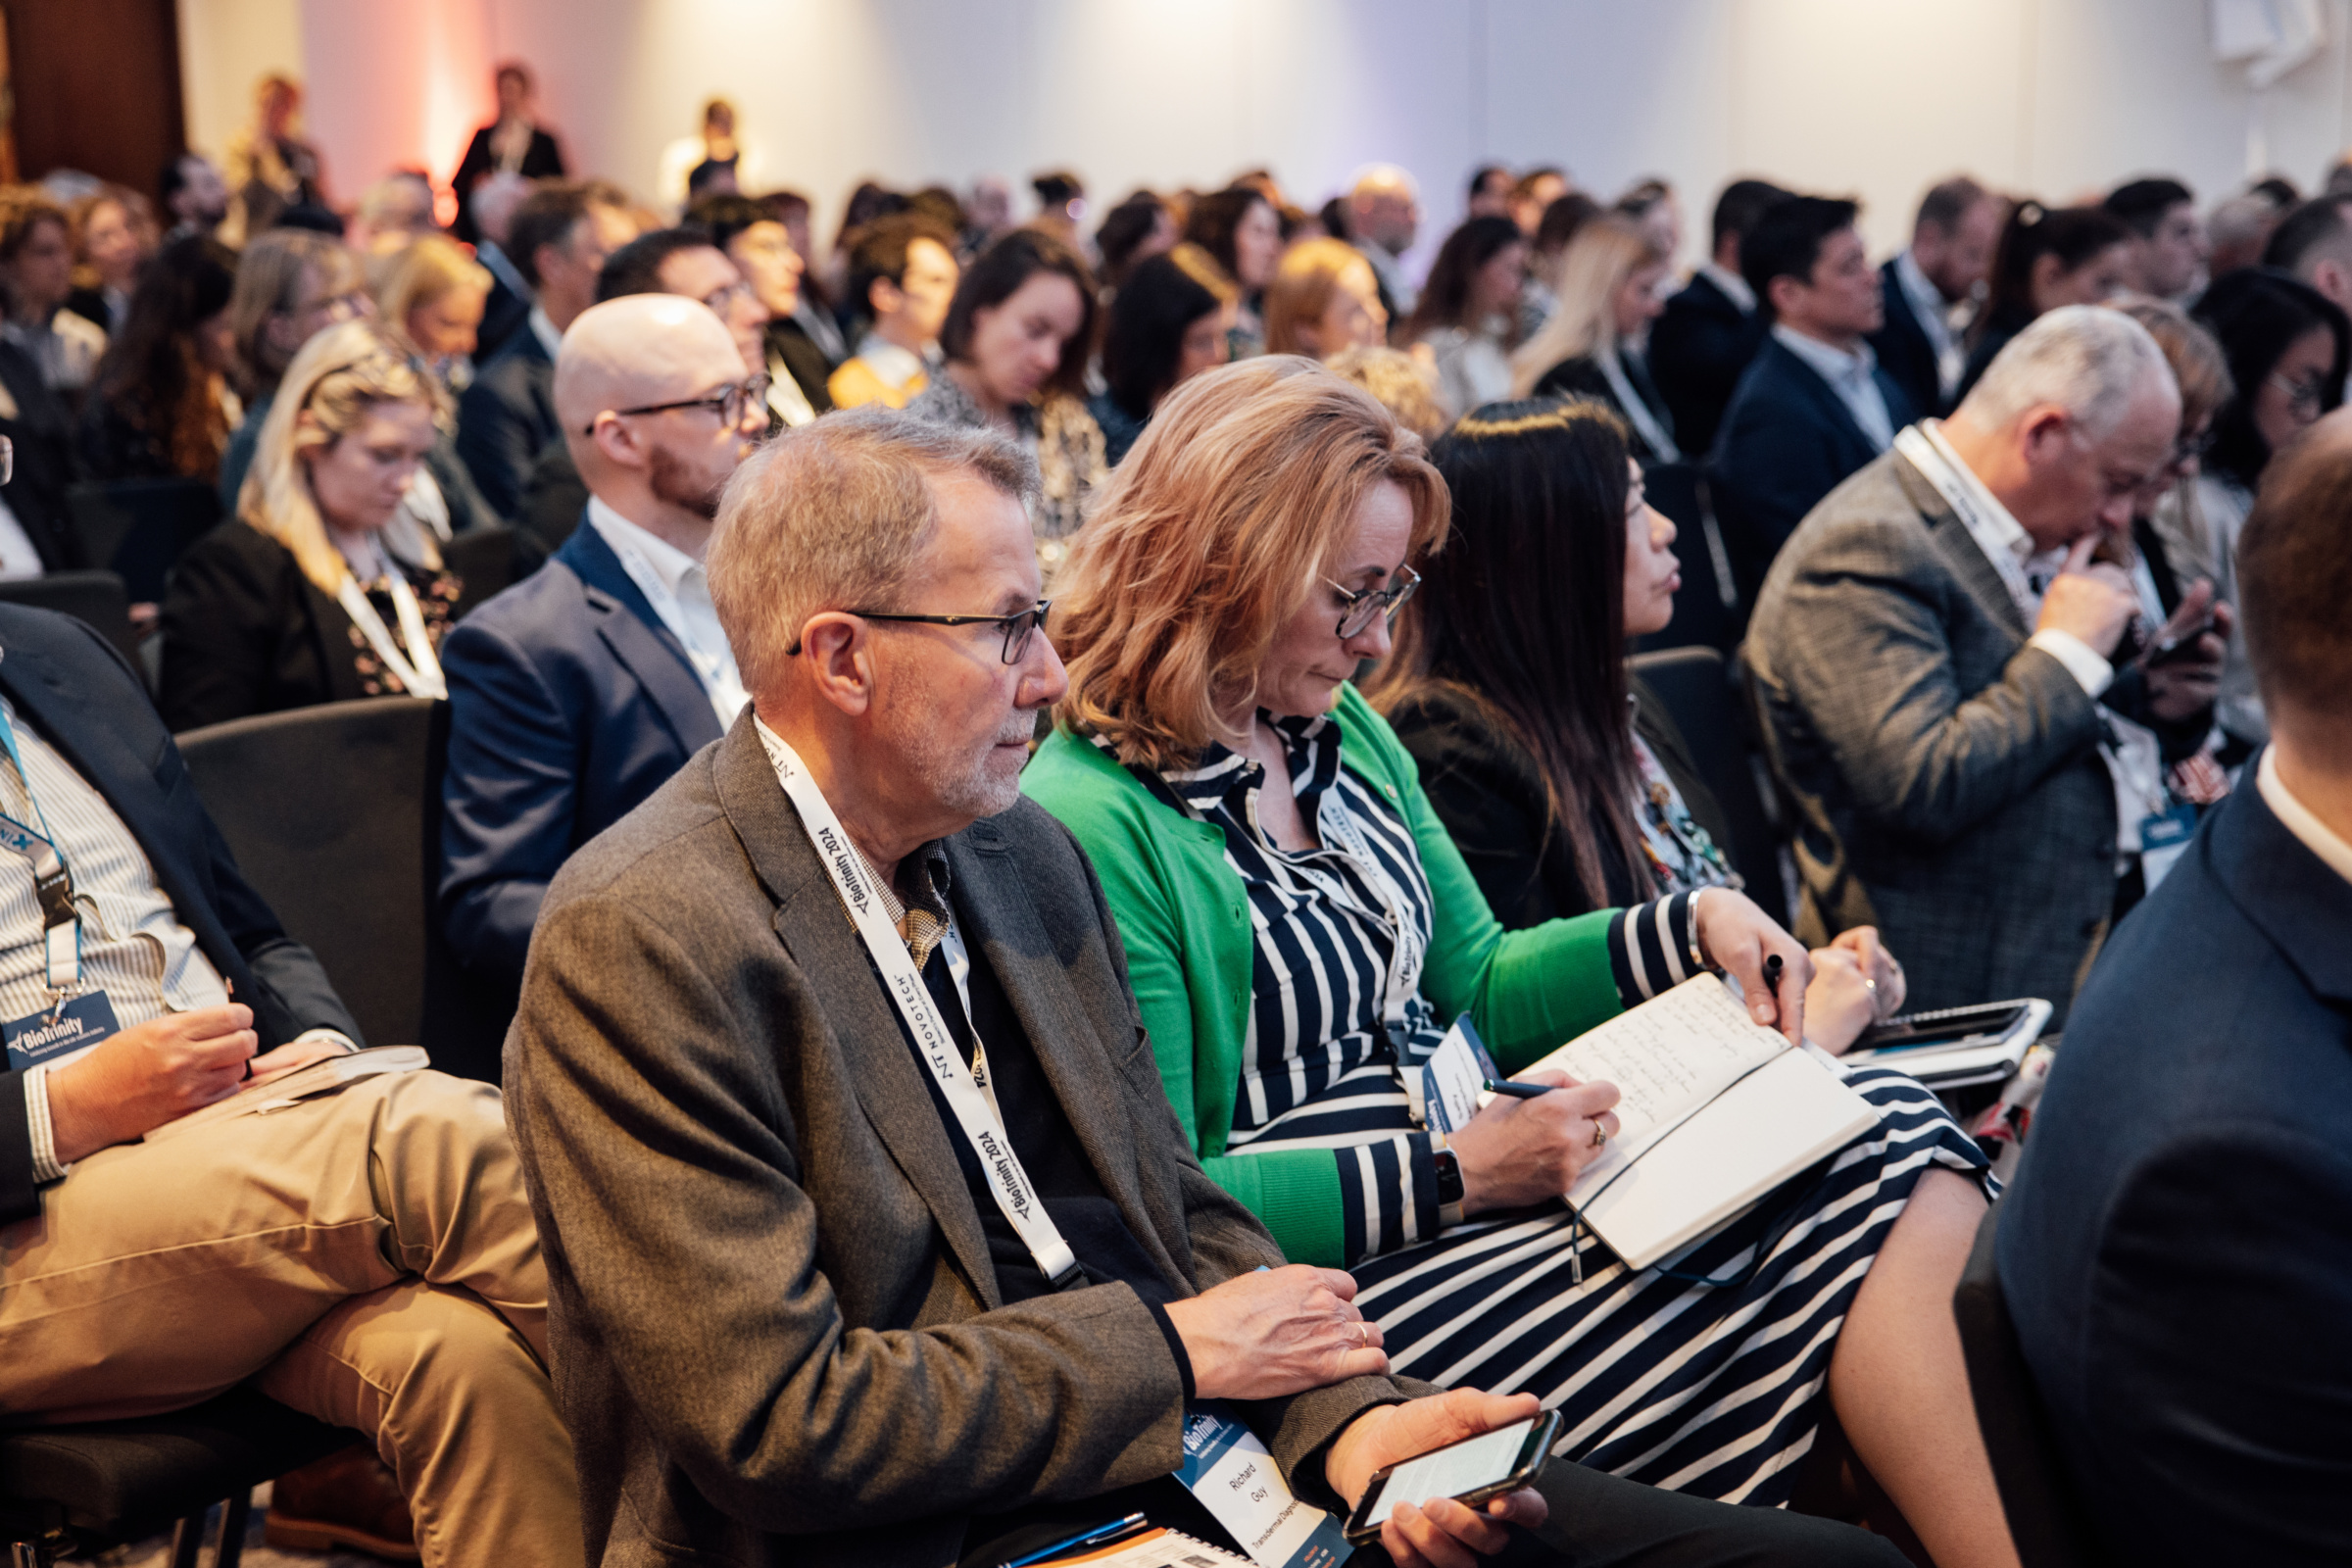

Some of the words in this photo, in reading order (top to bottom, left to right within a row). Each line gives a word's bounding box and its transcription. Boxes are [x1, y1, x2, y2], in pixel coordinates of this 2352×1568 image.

[818, 827, 840, 856] 2024
[835, 855, 865, 903] BioTrinity
[897, 977, 939, 1050] NOVOTECH
[22, 1016, 83, 1050] BioTrinity
[978, 1131, 1001, 1160] 2024
[996, 1158, 1026, 1208] BioTrinity
[1183, 1413, 1224, 1451] BioTrinity
[1229, 1461, 1256, 1492] Richard
[1250, 1486, 1269, 1503] Guy
[1251, 1516, 1284, 1550] Transdermal
[1278, 1499, 1300, 1521] Diagnost
